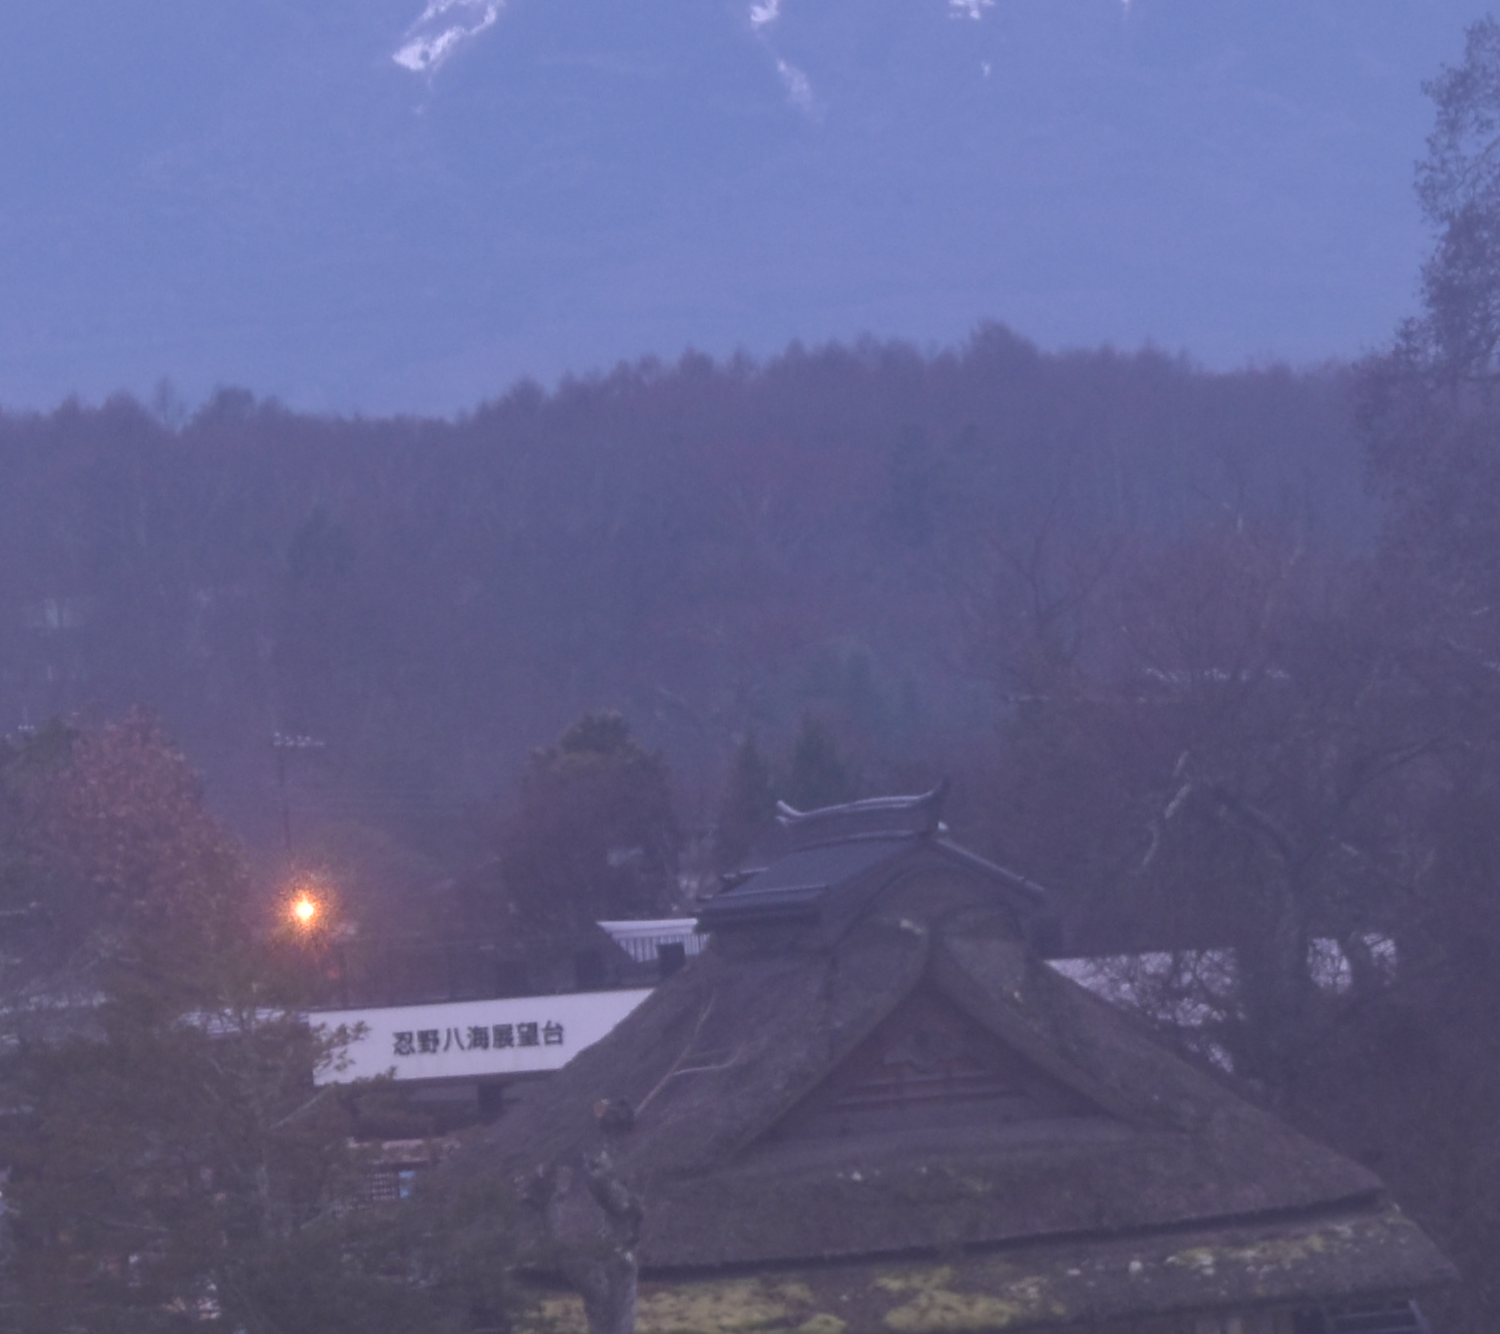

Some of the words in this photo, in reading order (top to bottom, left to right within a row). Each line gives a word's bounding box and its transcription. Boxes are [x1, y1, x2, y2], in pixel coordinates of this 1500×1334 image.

[393, 1021, 564, 1056] 忍野八海展望台
